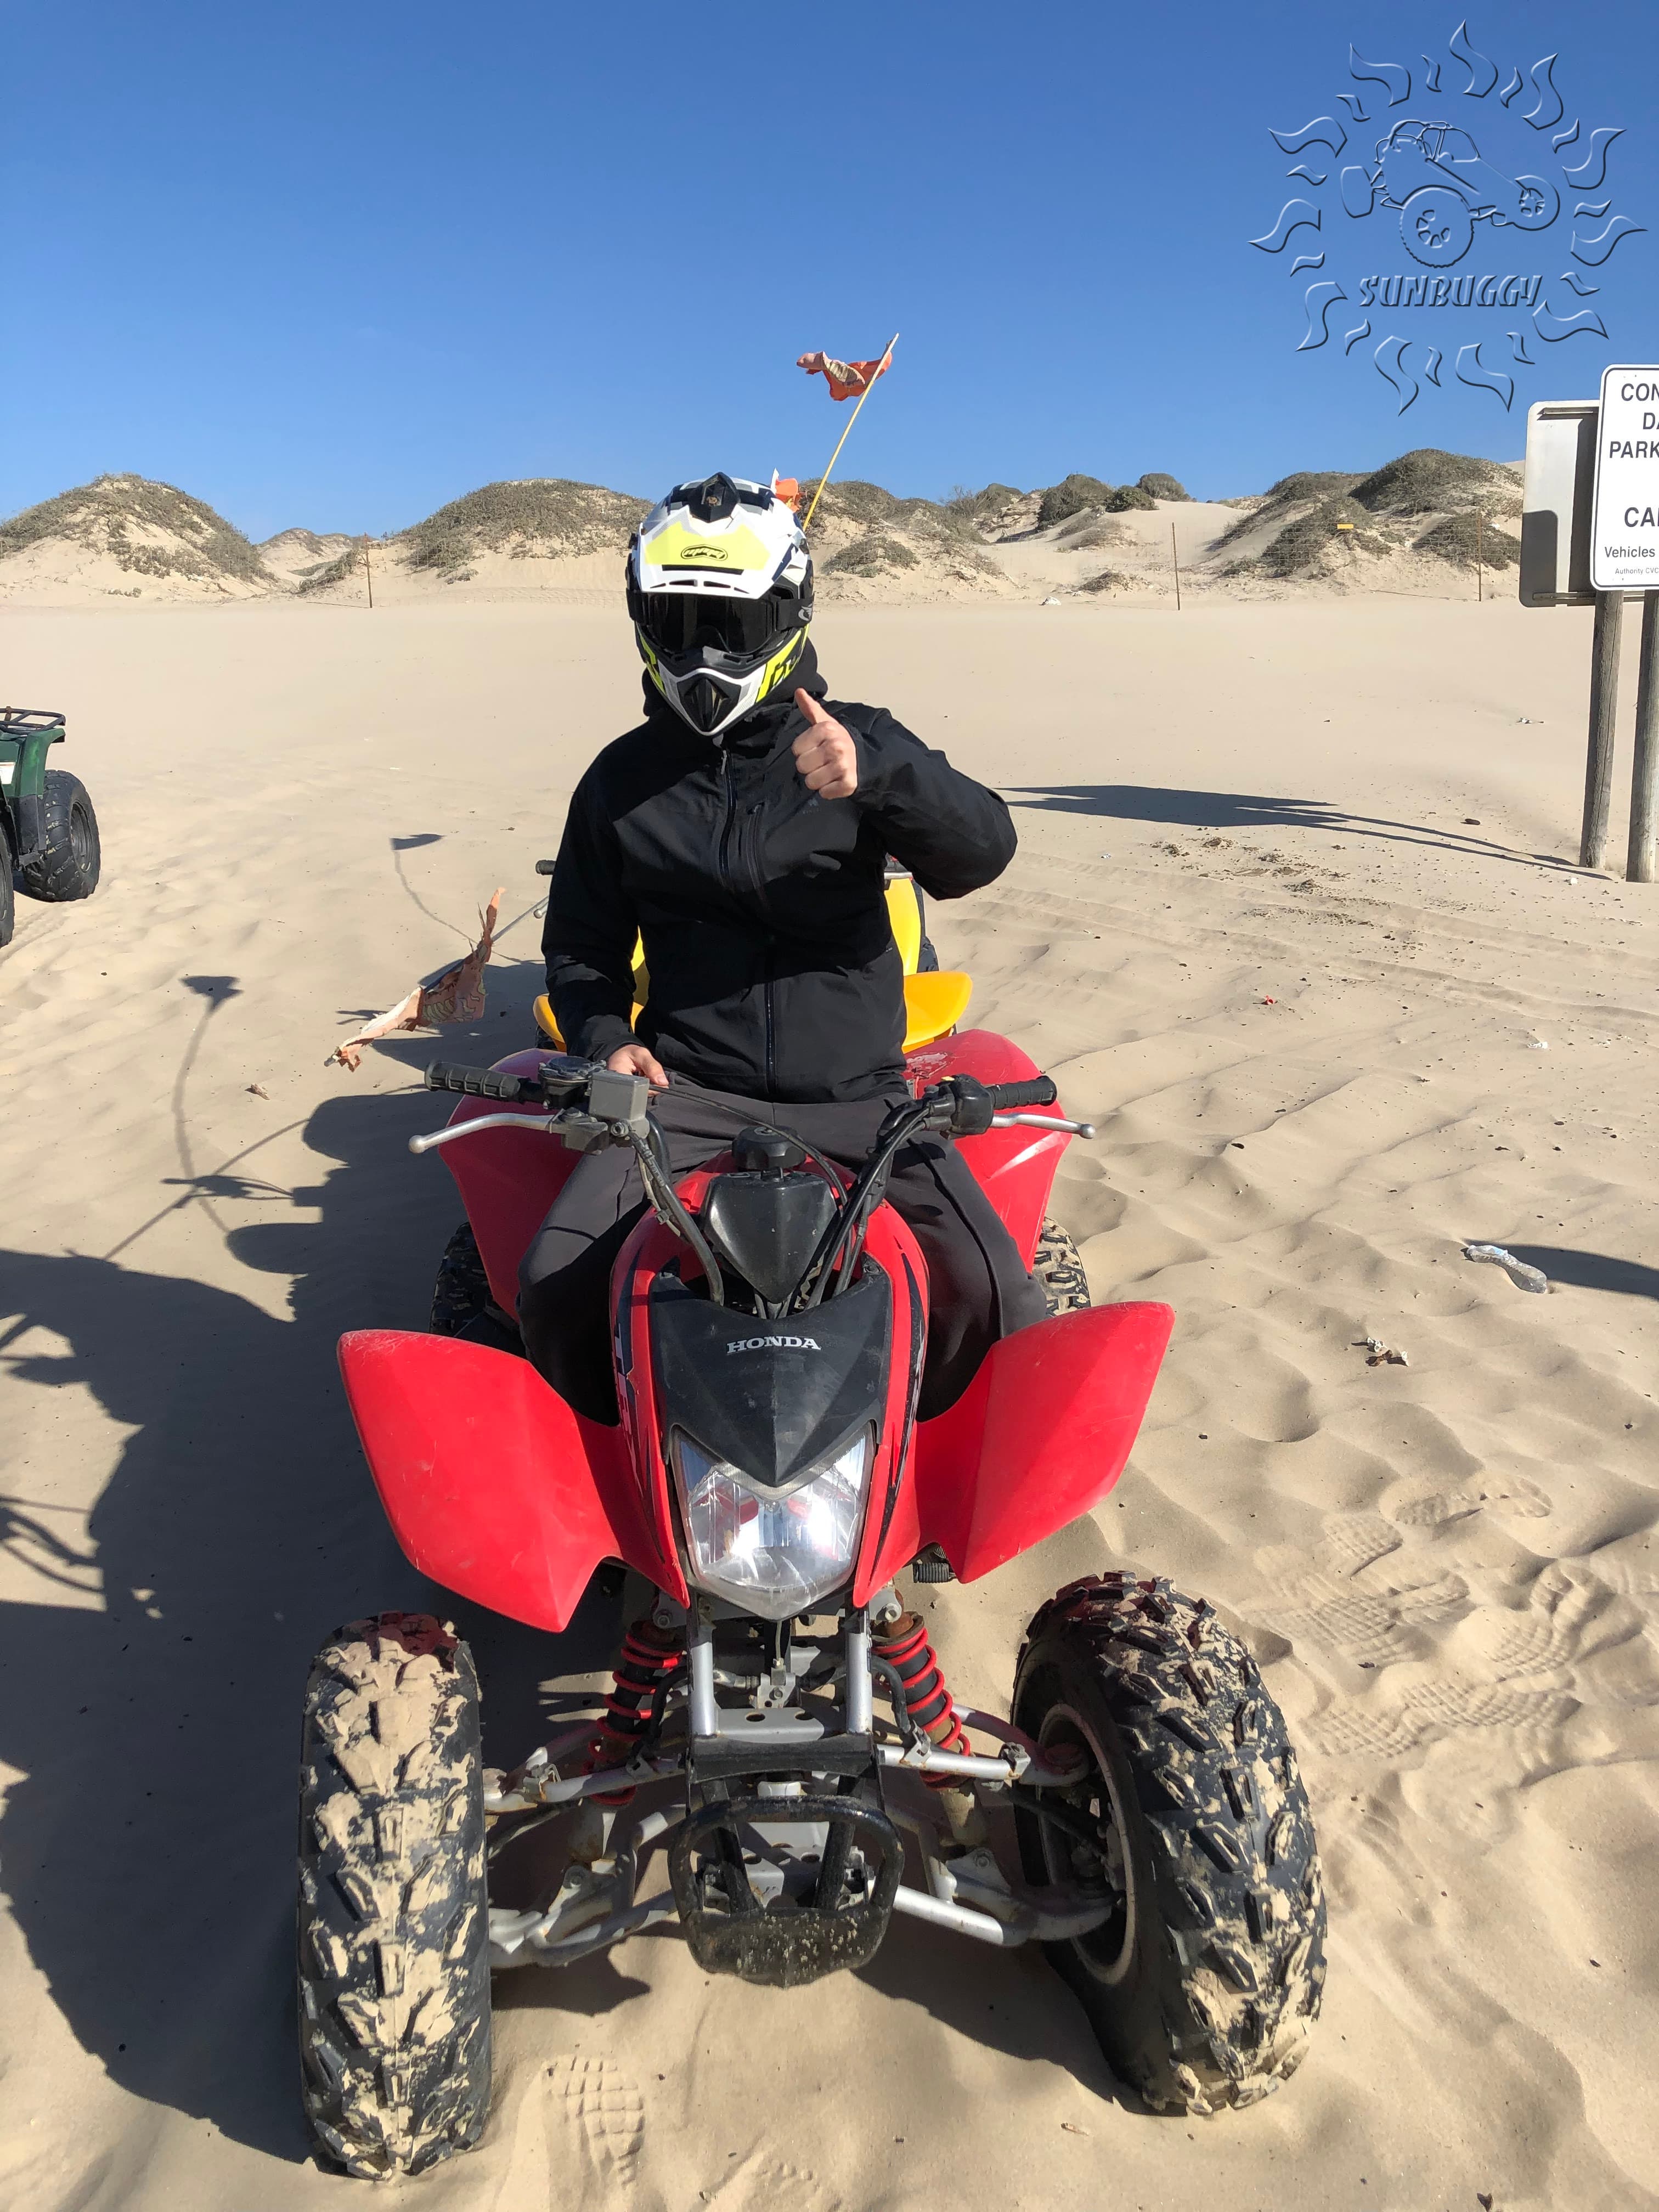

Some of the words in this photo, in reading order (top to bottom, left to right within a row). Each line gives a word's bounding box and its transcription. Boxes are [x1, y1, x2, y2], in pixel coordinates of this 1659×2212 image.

[1643, 412, 1659, 430] D
[1609, 441, 1659, 458] PARK
[1624, 507, 1659, 527] CA
[1604, 546, 1655, 557] Vehicles
[726, 1336, 821, 1354] HONDA
